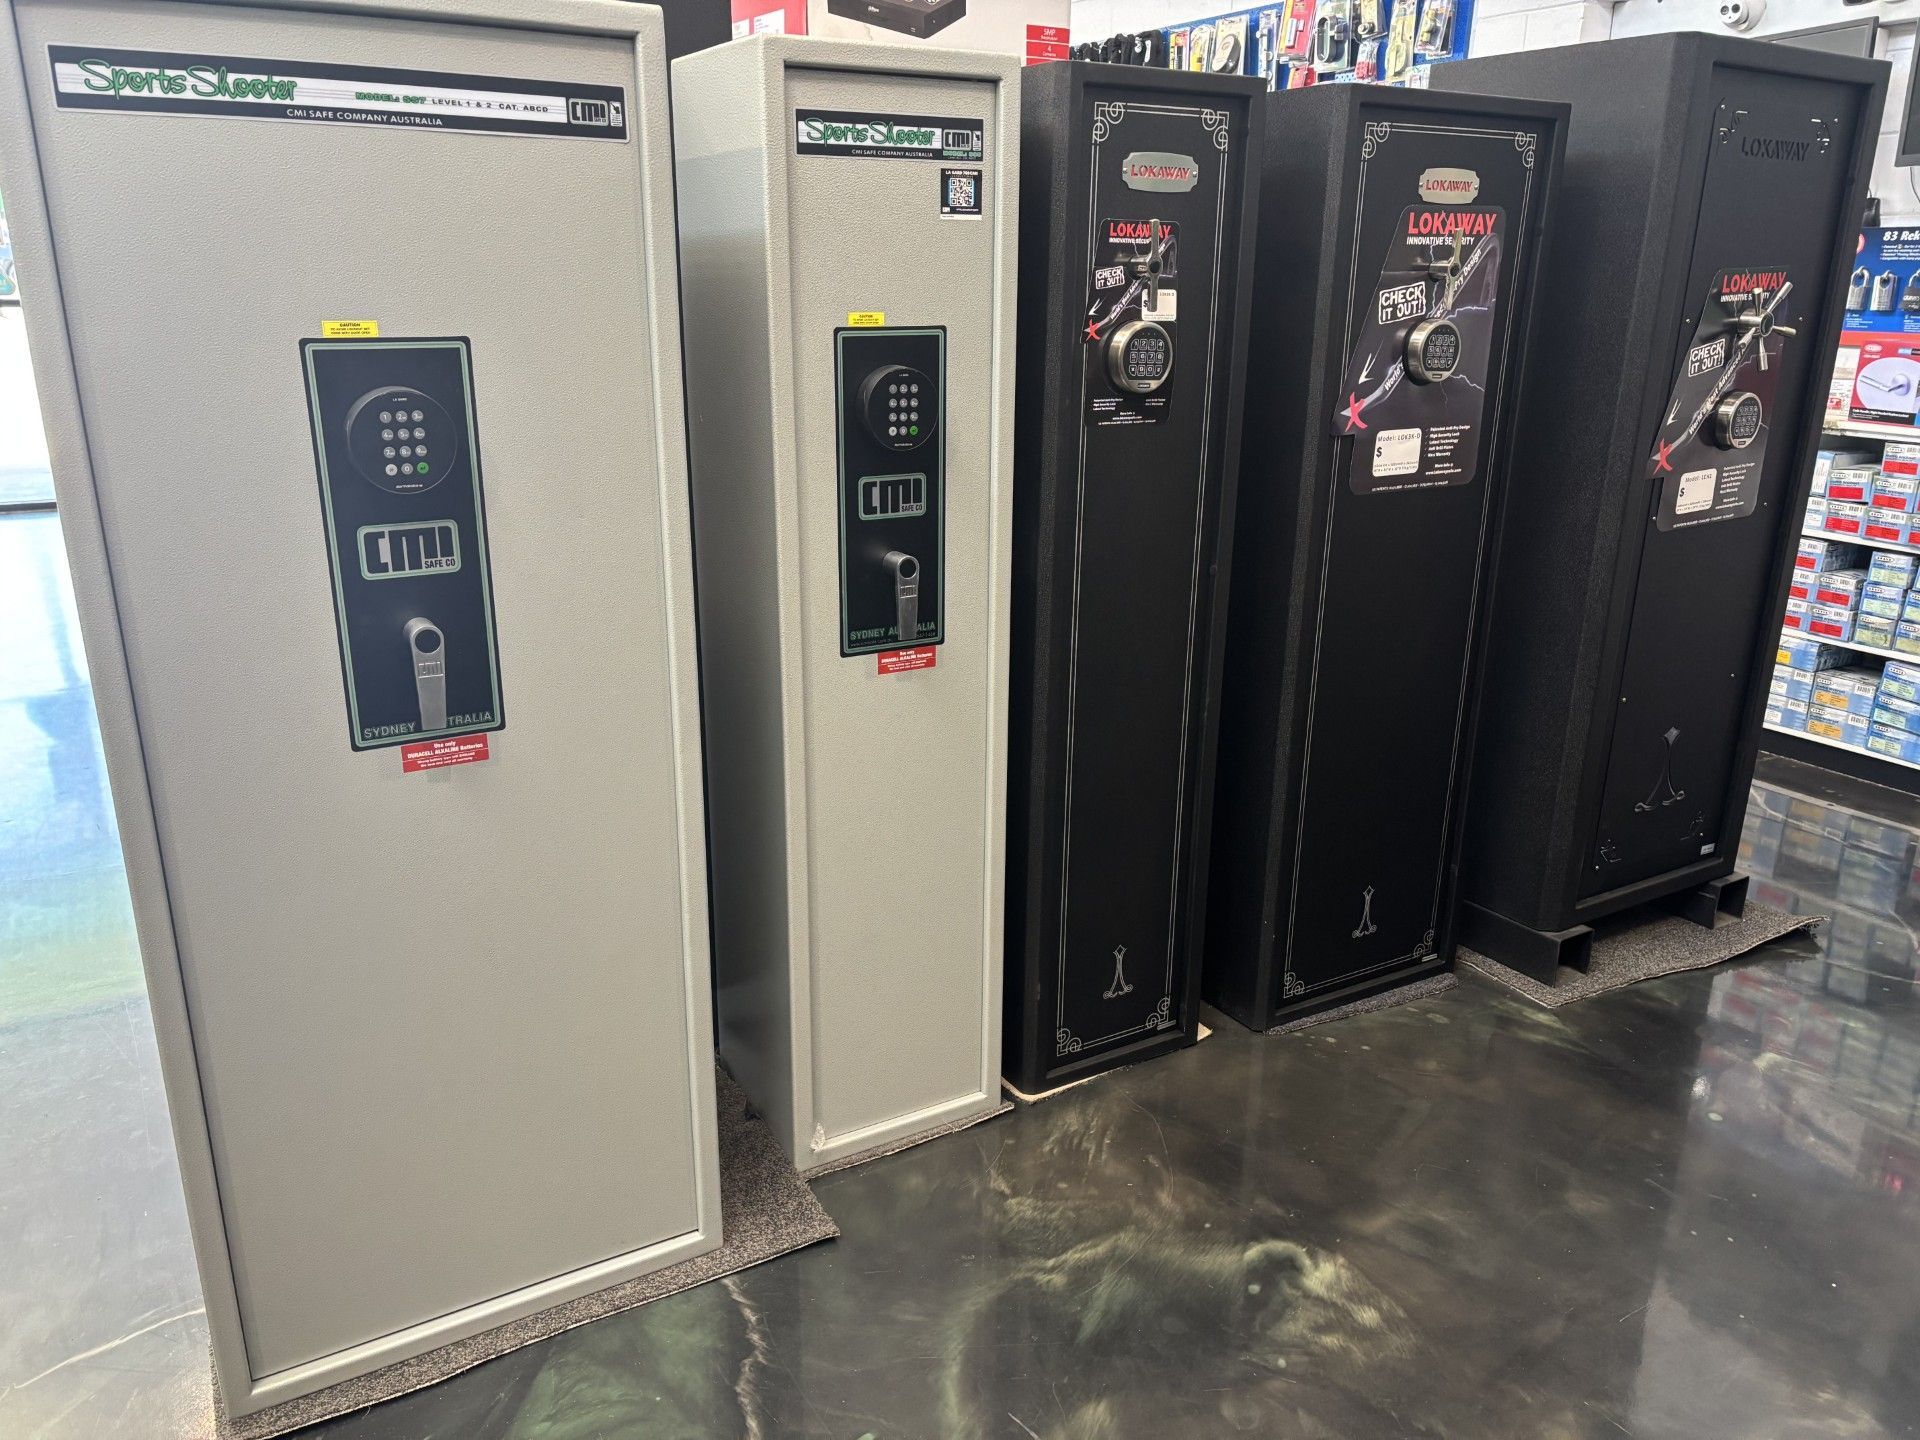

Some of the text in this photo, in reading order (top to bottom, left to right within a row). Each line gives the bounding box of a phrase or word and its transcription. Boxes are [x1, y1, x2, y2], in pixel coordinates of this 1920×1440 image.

[78, 59, 297, 101] Sports Shooter
[432, 98, 464, 107] LEVEL
[498, 103, 519, 112] CAT.
[523, 104, 549, 113] ABCD
[286, 108, 443, 126] CMI SAFE COMPANY AUSTRALIA
[804, 118, 936, 147] Sports Shooter
[1740, 136, 1810, 161] LOKAWAY
[1130, 164, 1190, 180] LOKAWAY
[1425, 179, 1473, 192] LOKAWAY
[1408, 212, 1497, 235] LOKAWAY
[1406, 236, 1474, 246] INNOVATIVE SERITY
[1883, 230, 1898, 241] 83
[1463, 248, 1482, 277] Design
[1098, 267, 1123, 279] CHECK
[1098, 279, 1104, 288] IT
[1722, 272, 1786, 294] LOKAWAY
[1382, 285, 1422, 306] CHECK
[1720, 293, 1748, 302] INNOVATIVE
[1382, 300, 1422, 322] IT OUT!
[1690, 342, 1723, 361] CHECK
[1691, 354, 1722, 374] IT OUT!
[1378, 434, 1396, 442] Model:
[1376, 446, 1383, 458] $
[1679, 487, 1685, 497] $
[901, 504, 914, 512] SAFE
[424, 558, 456, 569] SAFE CO
[850, 627, 884, 640] SYDNEY
[888, 620, 936, 637] AUALIA
[364, 712, 492, 739] SYDNEY TRALIA
